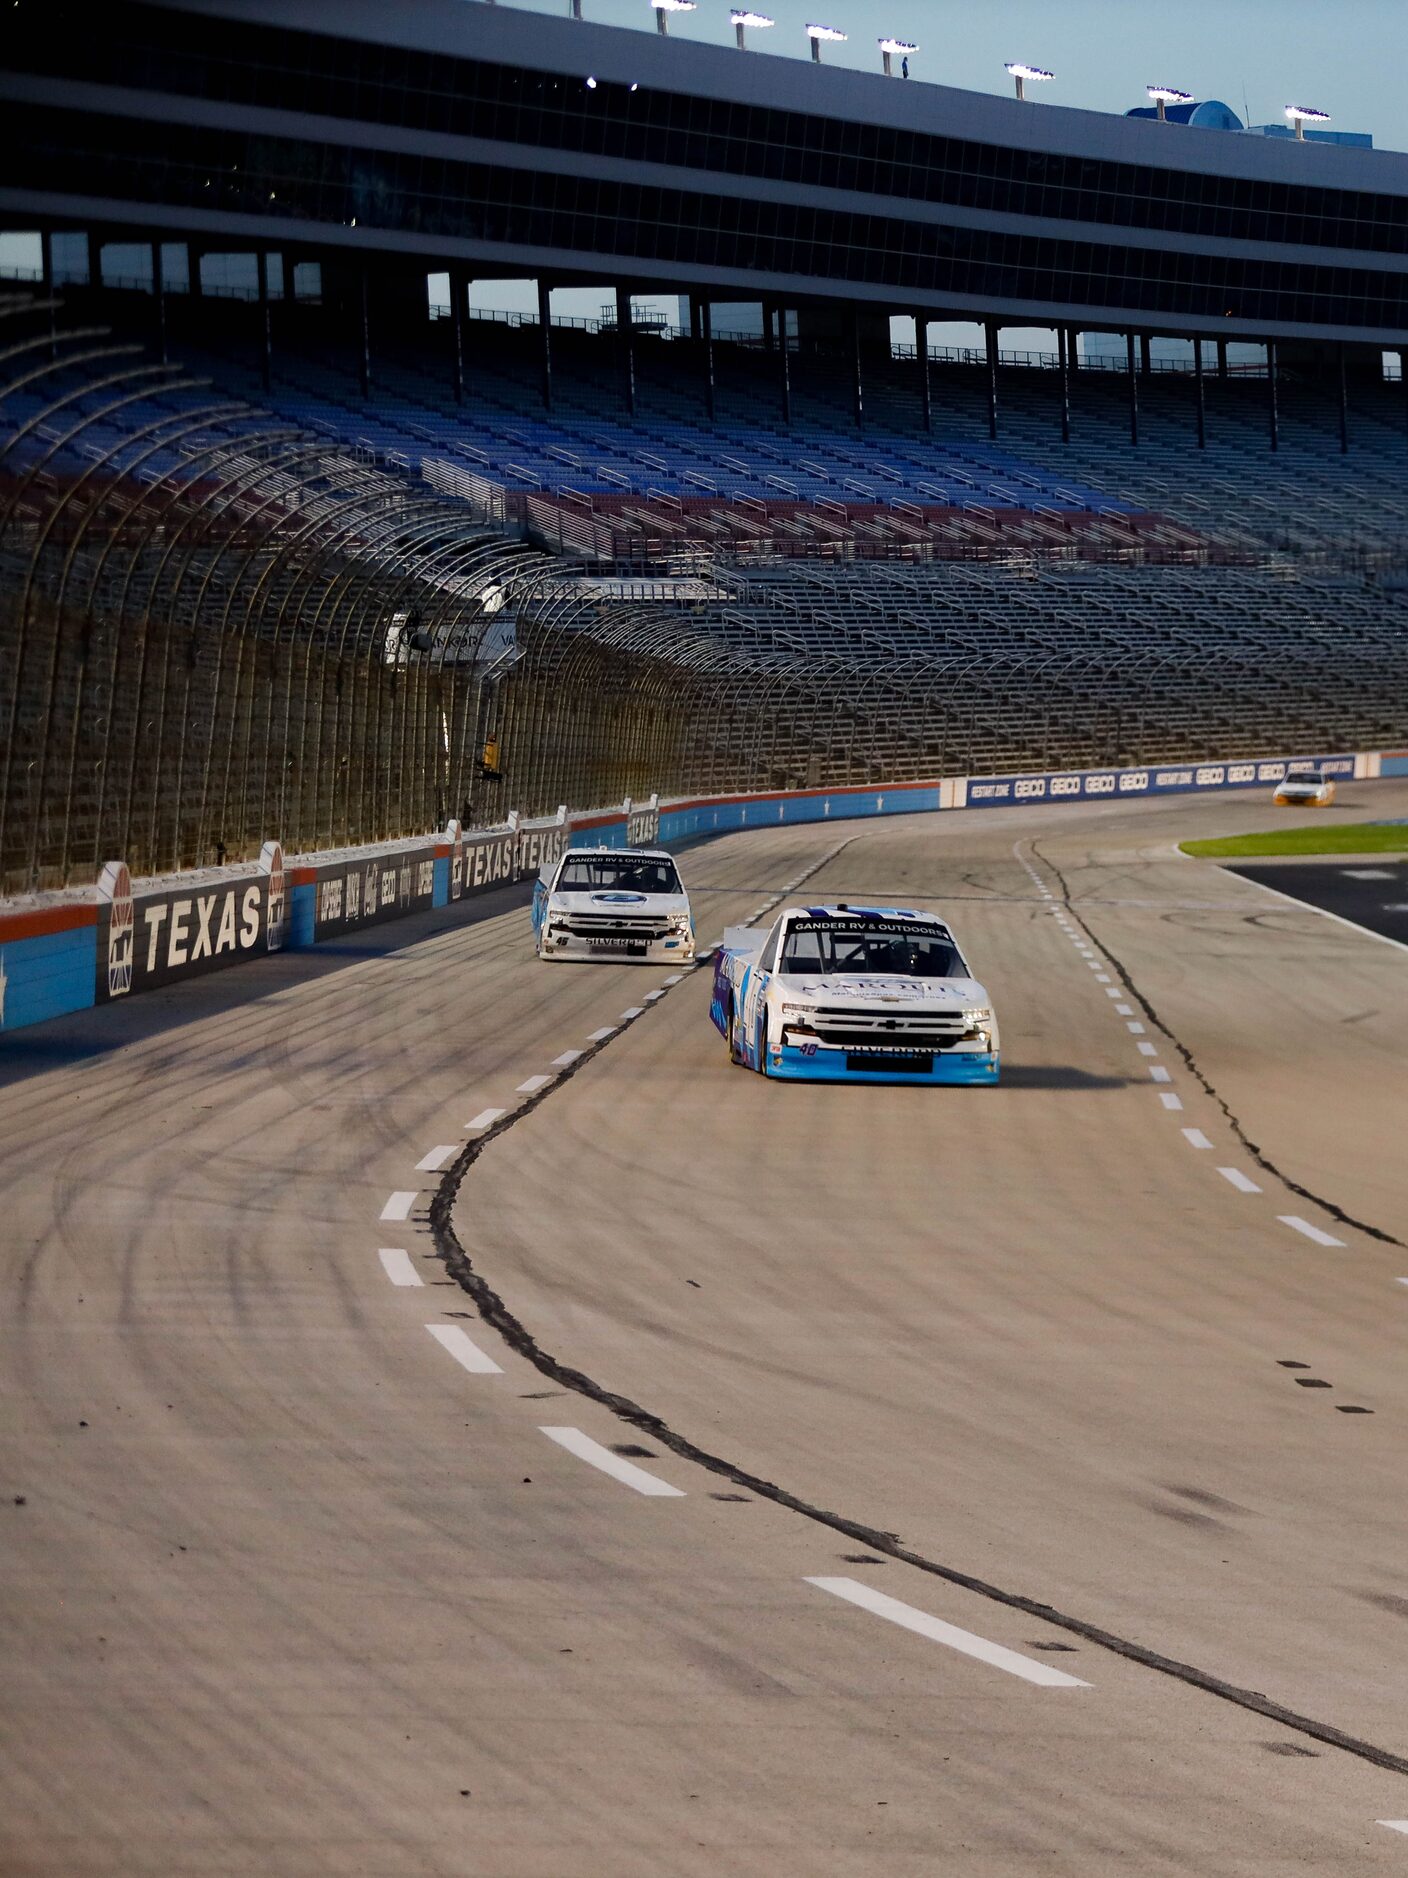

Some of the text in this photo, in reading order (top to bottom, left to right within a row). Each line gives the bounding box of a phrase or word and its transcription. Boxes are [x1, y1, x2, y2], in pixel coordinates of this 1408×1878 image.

[1015, 779, 1045, 798] GEICO
[1050, 777, 1080, 795] GEICO
[1085, 775, 1115, 793] GEICO
[1119, 773, 1148, 791] GEICO
[1196, 767, 1224, 785] GEICO
[1228, 765, 1255, 782] GEICO
[1258, 763, 1285, 781] GEICO
[632, 815, 654, 844] TEXAS
[466, 840, 511, 888] TEXAS
[521, 831, 561, 870] TEXAS
[625, 858, 669, 867] OUTDOORS
[145, 886, 260, 973] TEXAS
[556, 937, 569, 947] 45
[795, 922, 846, 930] GANDER
[850, 922, 866, 930] RV
[878, 924, 943, 935] OUTDOORS
[800, 1043, 819, 1056] 40
